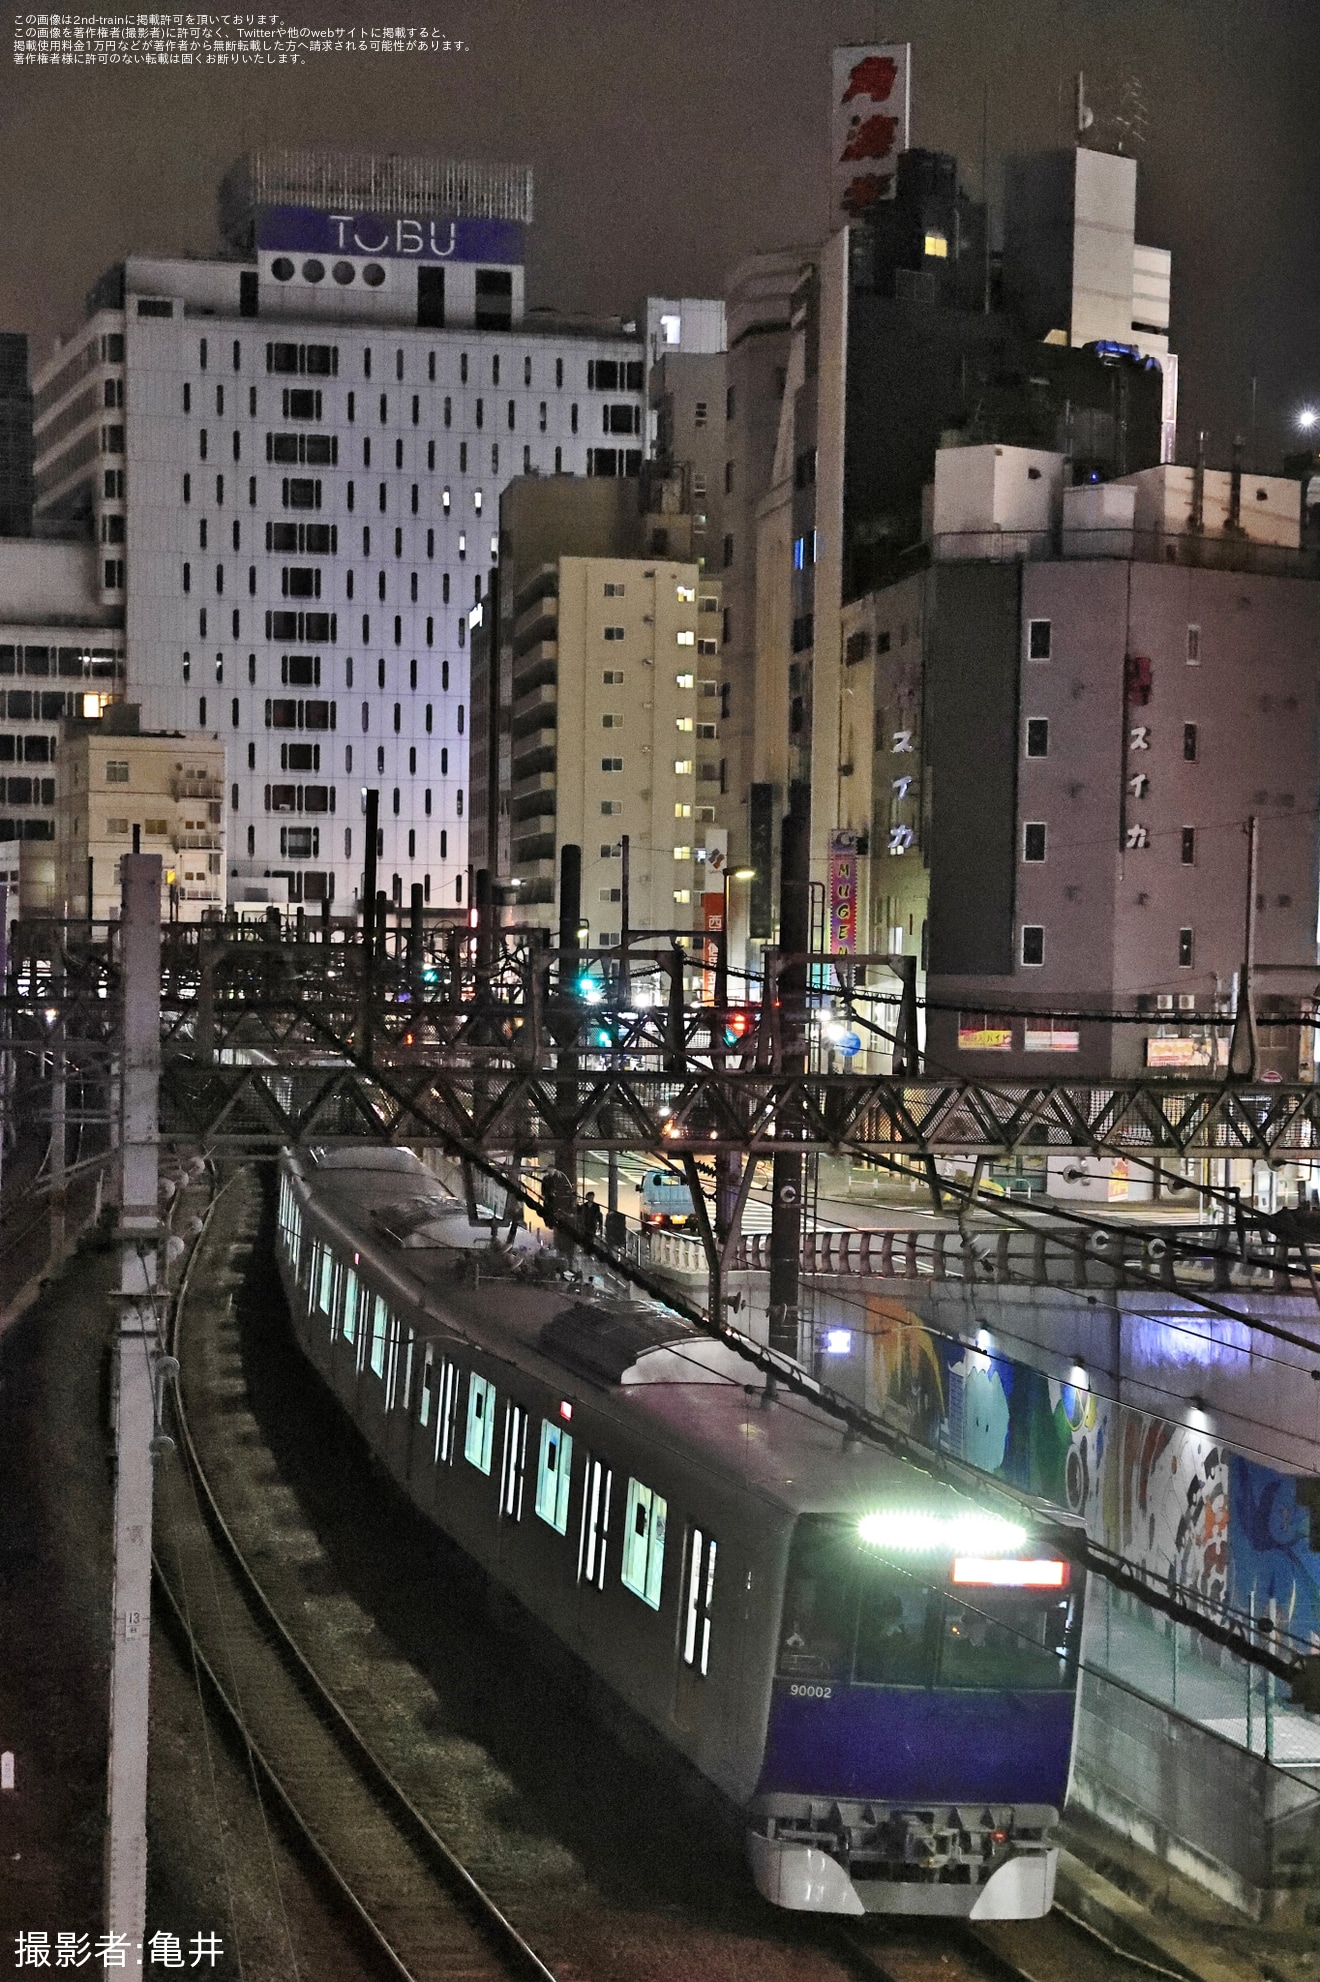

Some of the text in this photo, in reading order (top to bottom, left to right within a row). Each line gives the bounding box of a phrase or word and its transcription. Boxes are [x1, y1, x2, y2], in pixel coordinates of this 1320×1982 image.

[329, 215, 456, 256] TOBU
[1125, 726, 1149, 849] スイカ
[790, 1684, 832, 1699] 90002
